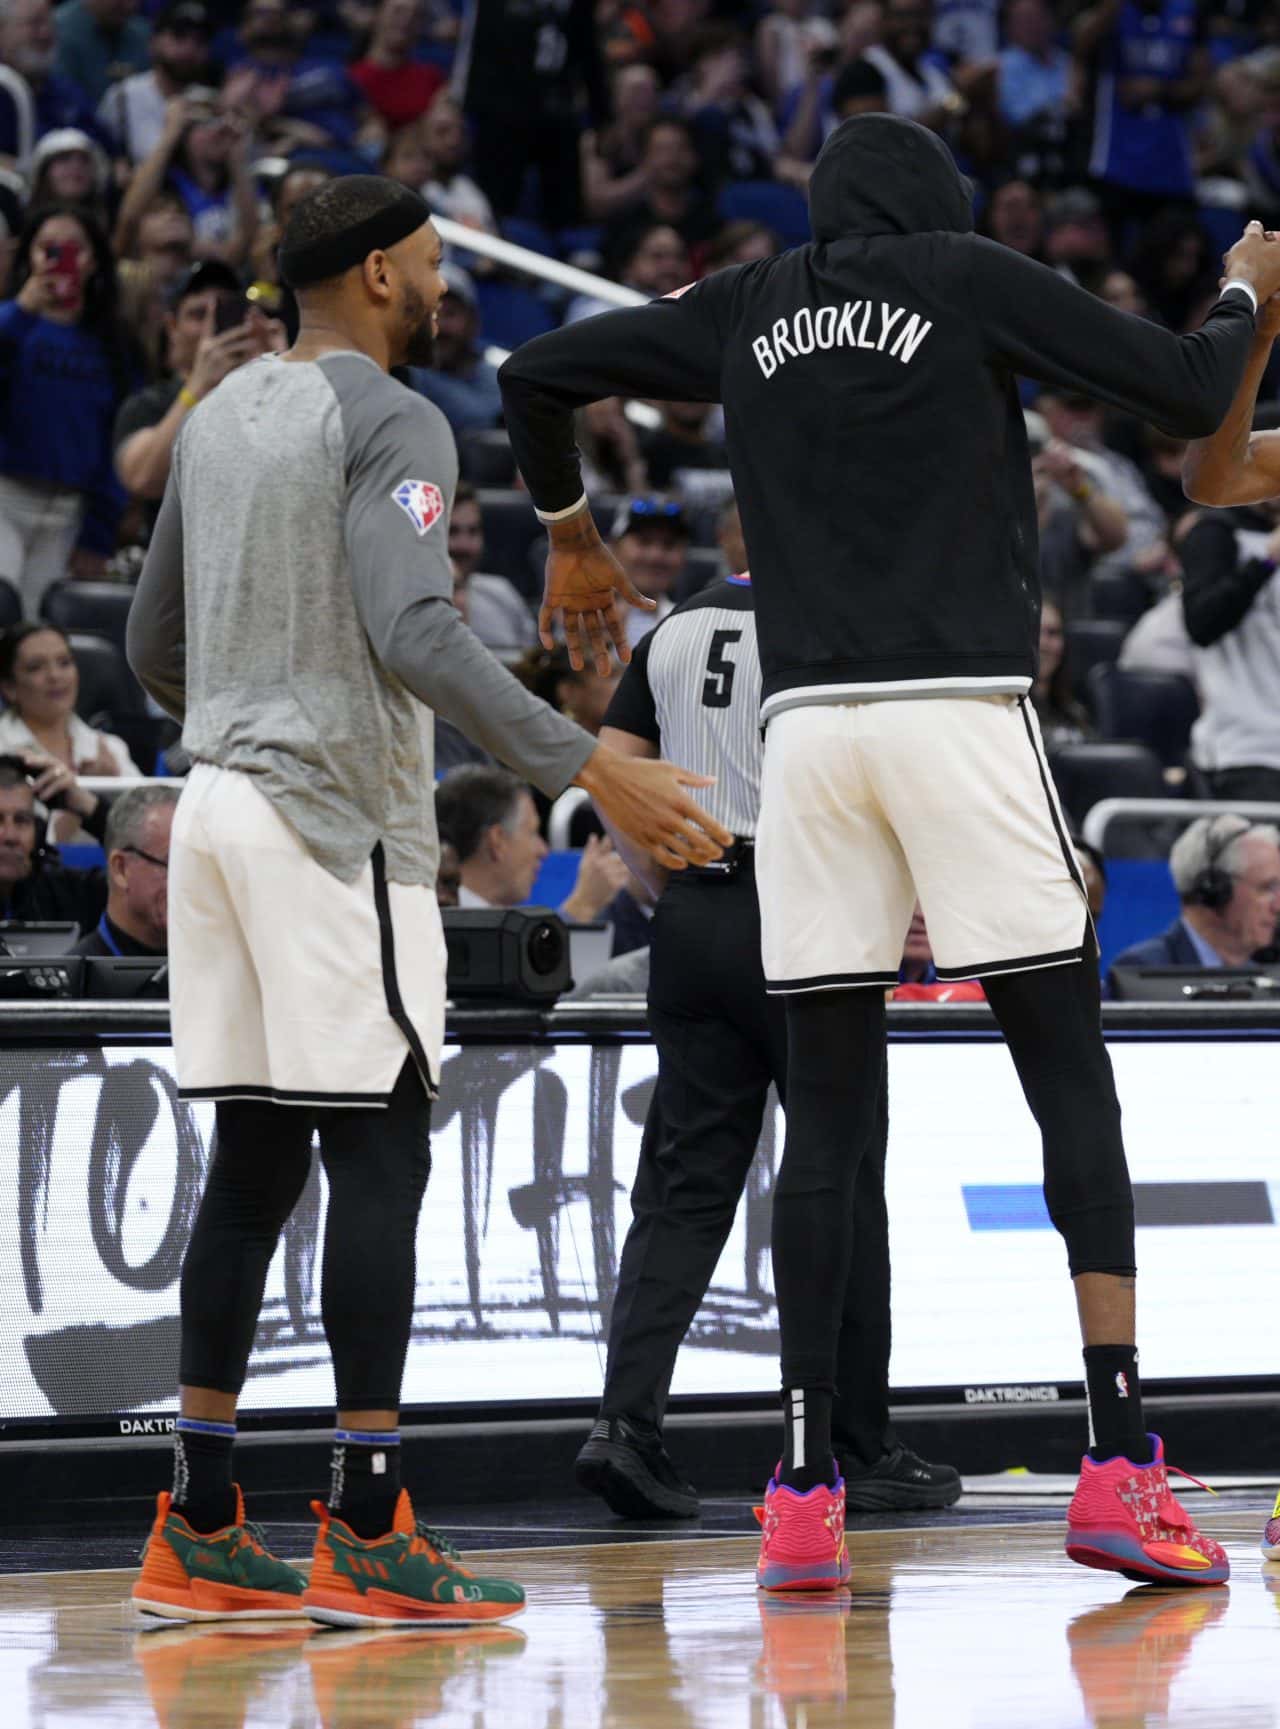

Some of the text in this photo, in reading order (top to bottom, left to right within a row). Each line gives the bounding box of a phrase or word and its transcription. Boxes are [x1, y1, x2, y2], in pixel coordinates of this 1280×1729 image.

[752, 300, 932, 379] BROOKLYN
[702, 630, 743, 708] 5
[965, 1386, 1060, 1403] DAKTRONICS
[120, 1418, 176, 1434] DAKTR
